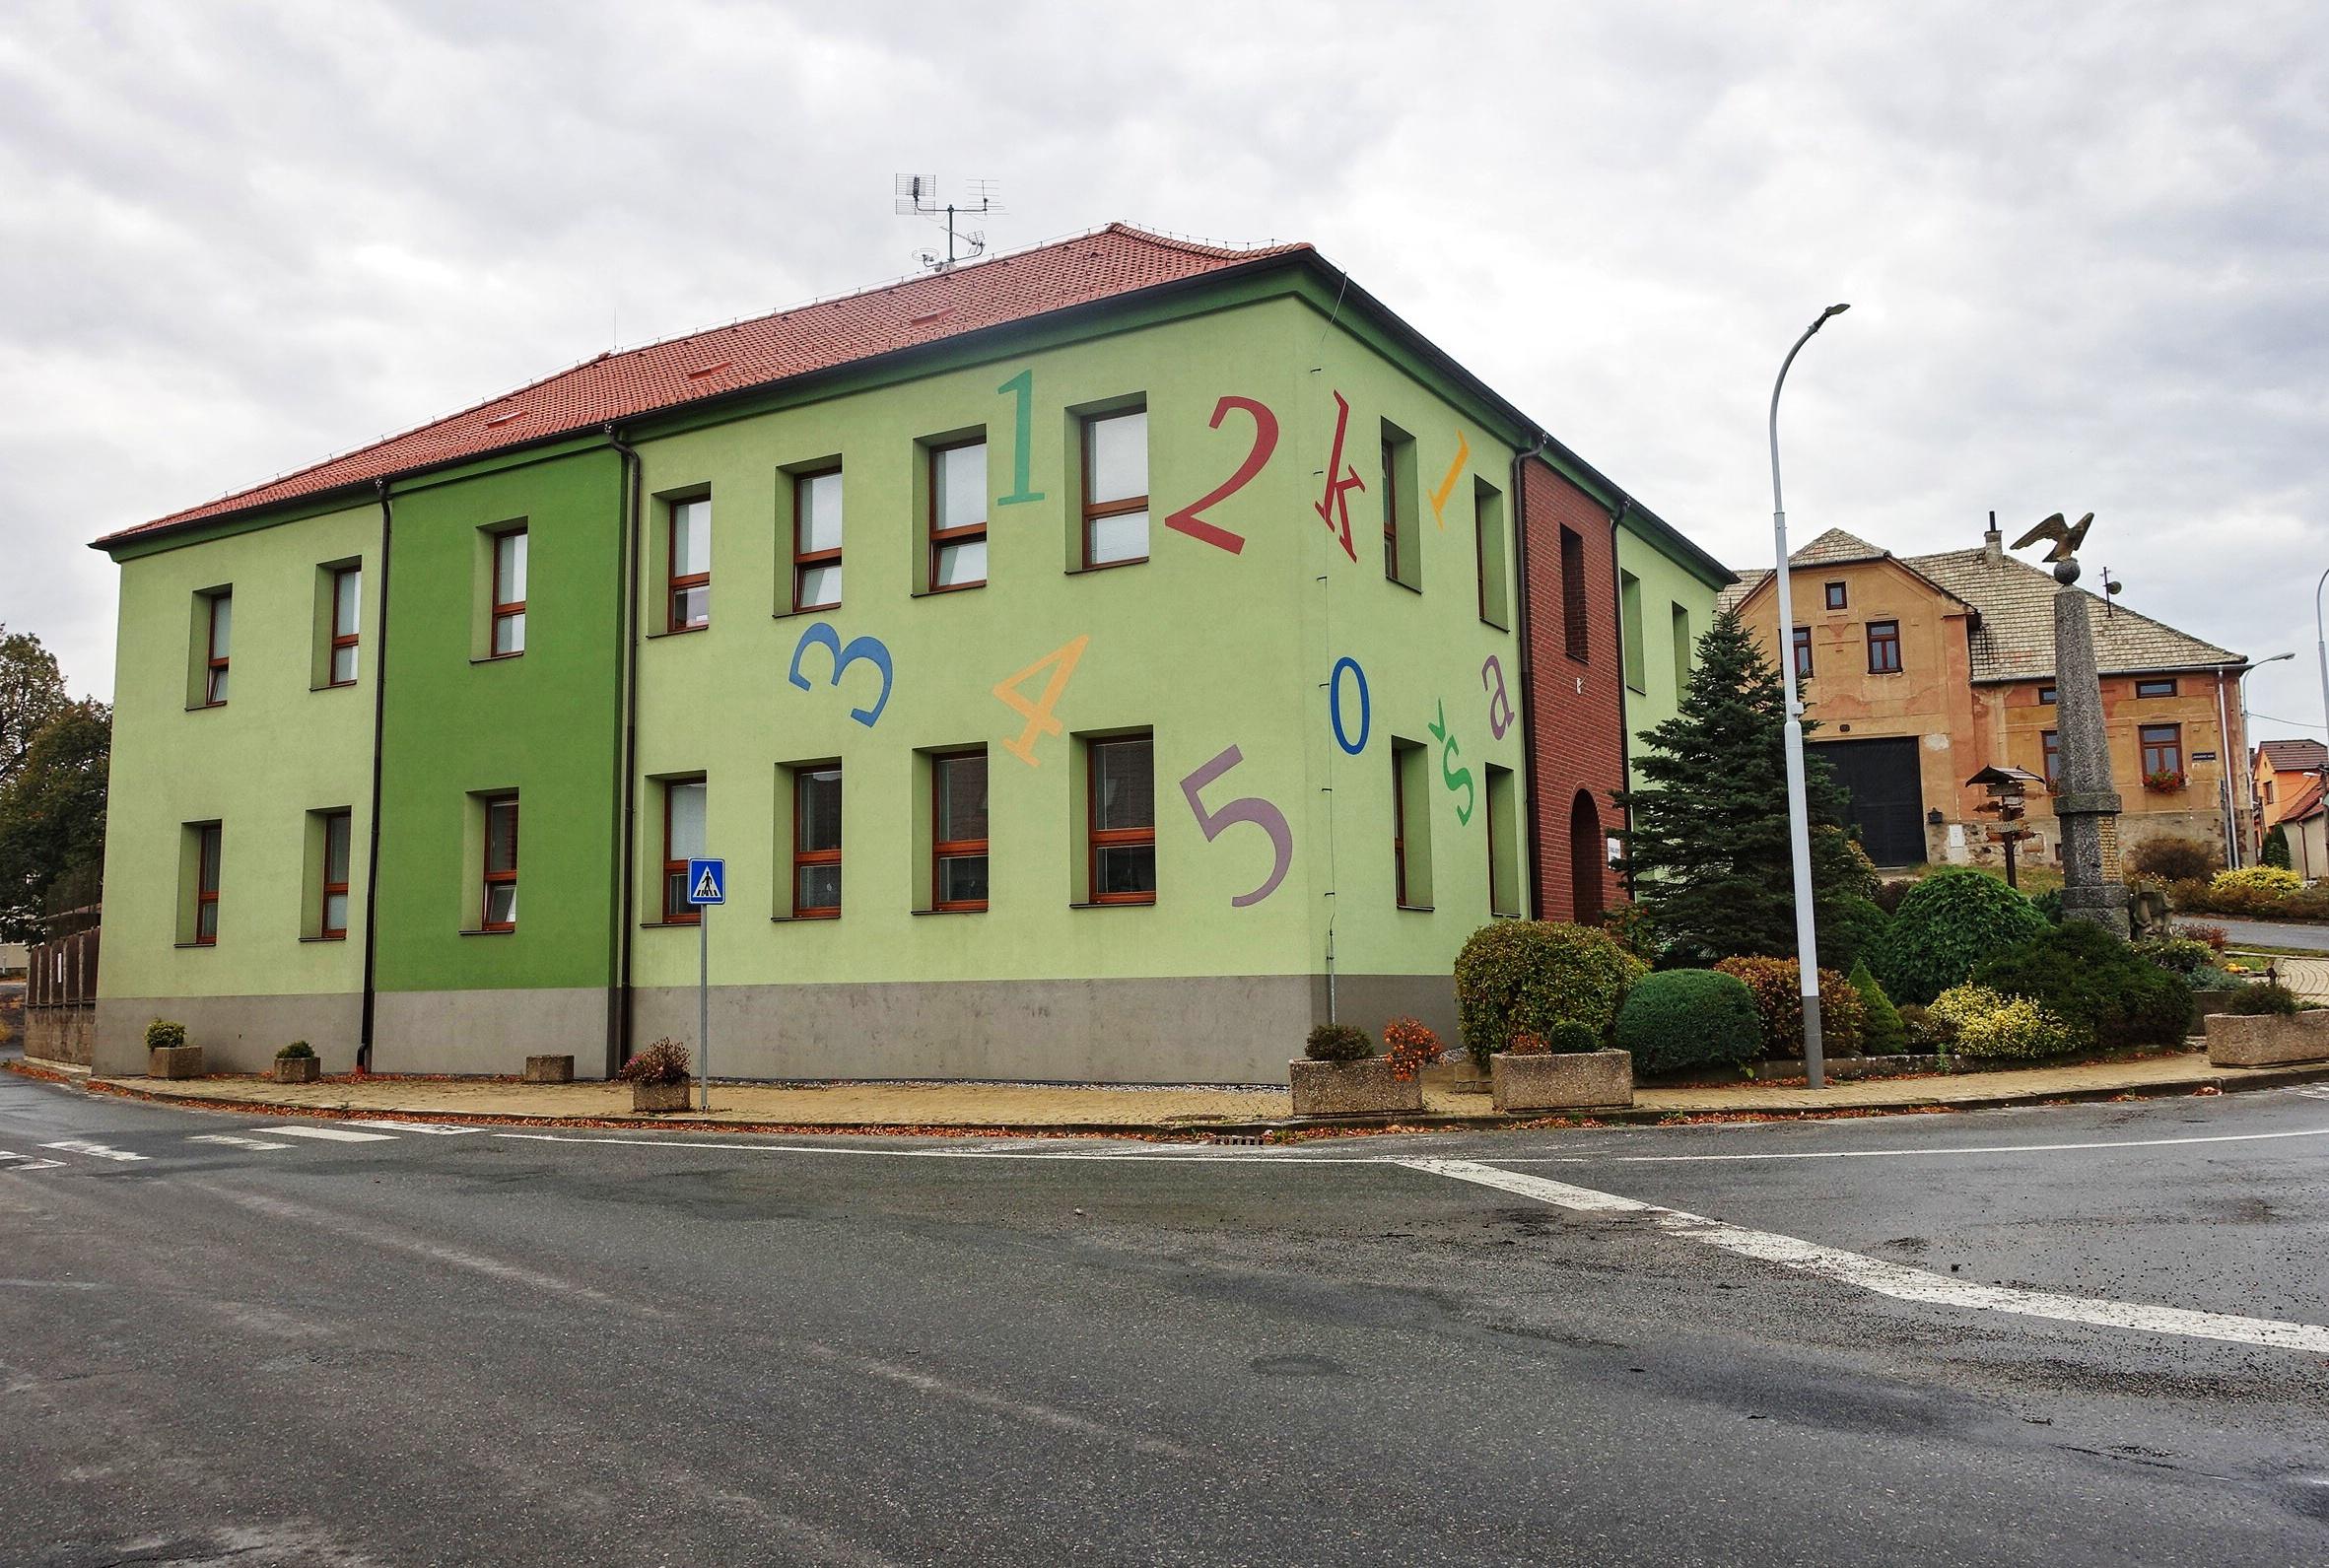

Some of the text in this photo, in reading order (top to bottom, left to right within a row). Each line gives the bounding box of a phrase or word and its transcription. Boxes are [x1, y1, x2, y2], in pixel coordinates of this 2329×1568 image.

[997, 369, 1045, 507] 1
[1164, 395, 1279, 555] 2
[1315, 389, 1366, 563] k
[788, 622, 893, 728] 3
[993, 635, 1090, 768] 4
[1481, 654, 1515, 741] a
[1179, 744, 1293, 908] 5
